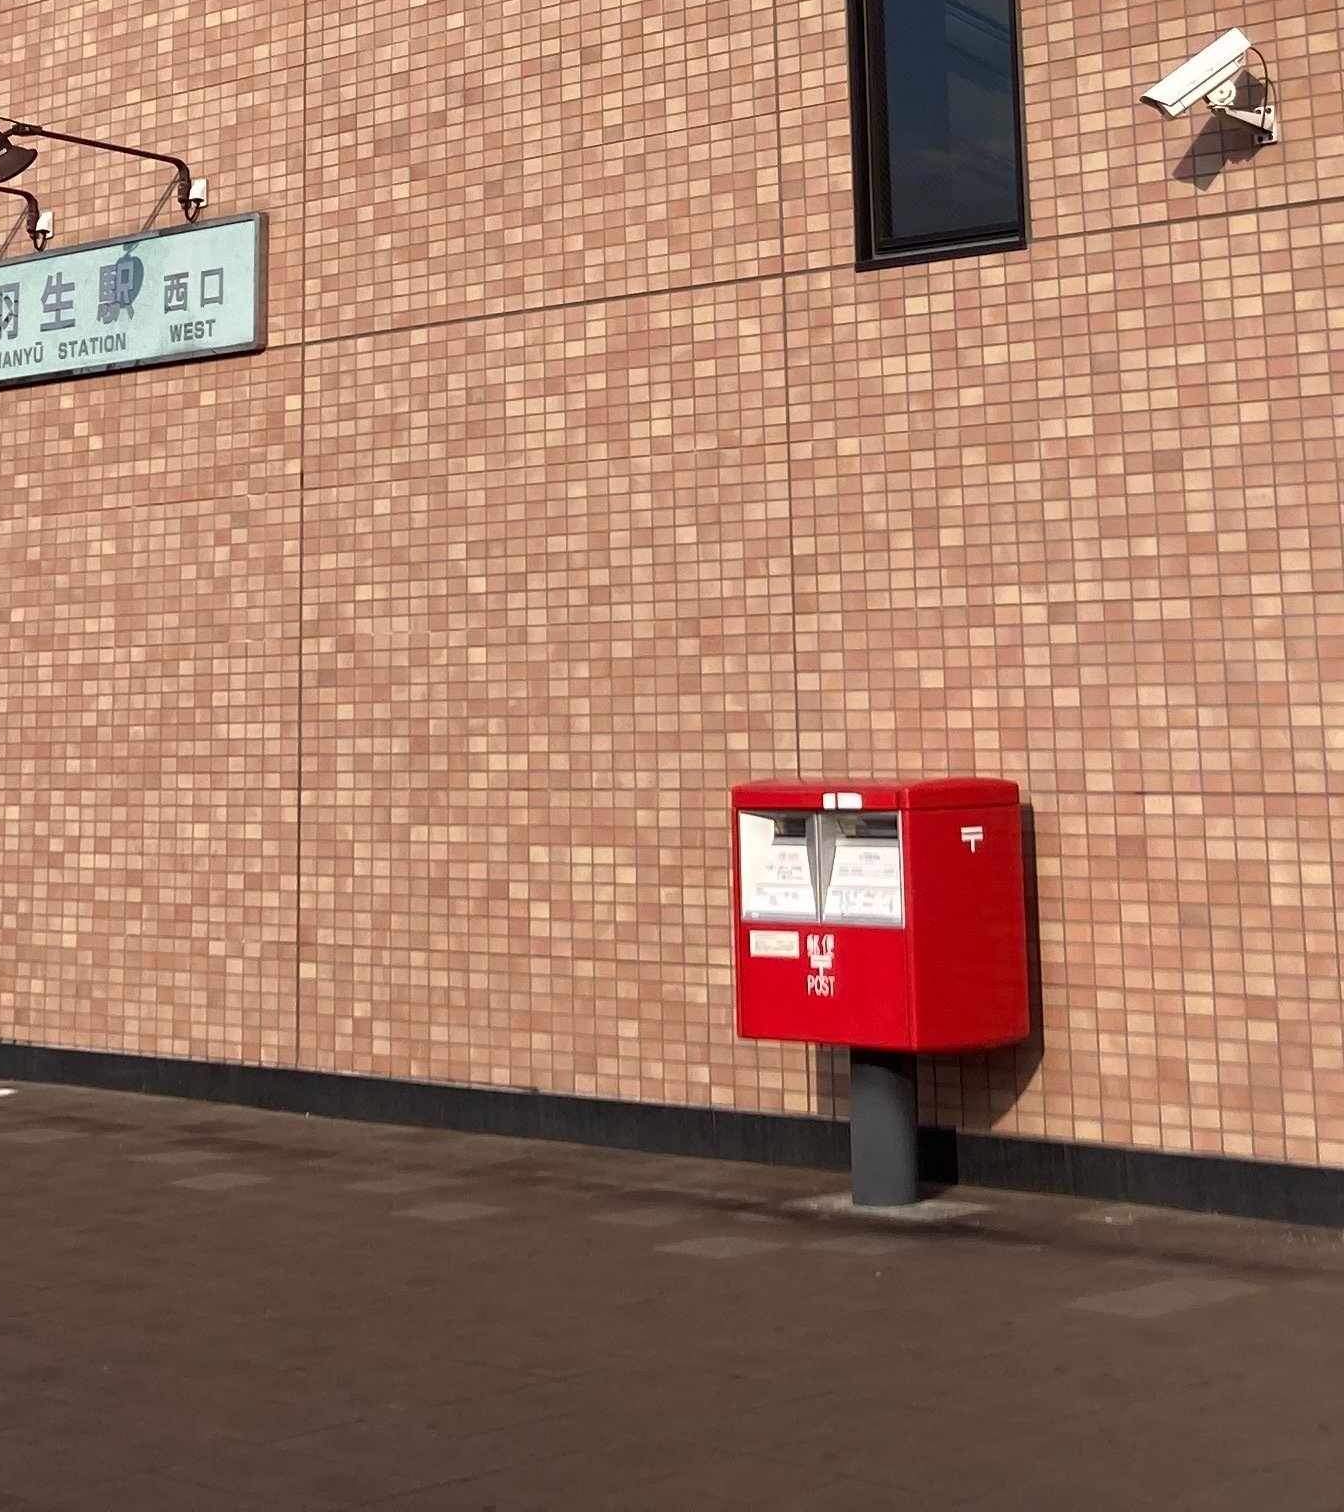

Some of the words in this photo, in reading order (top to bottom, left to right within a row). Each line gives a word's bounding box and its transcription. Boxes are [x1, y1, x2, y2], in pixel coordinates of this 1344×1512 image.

[164, 267, 225, 315] 西口
[58, 332, 127, 360] STATION
[169, 319, 217, 343] WEST
[807, 974, 836, 998] POST
